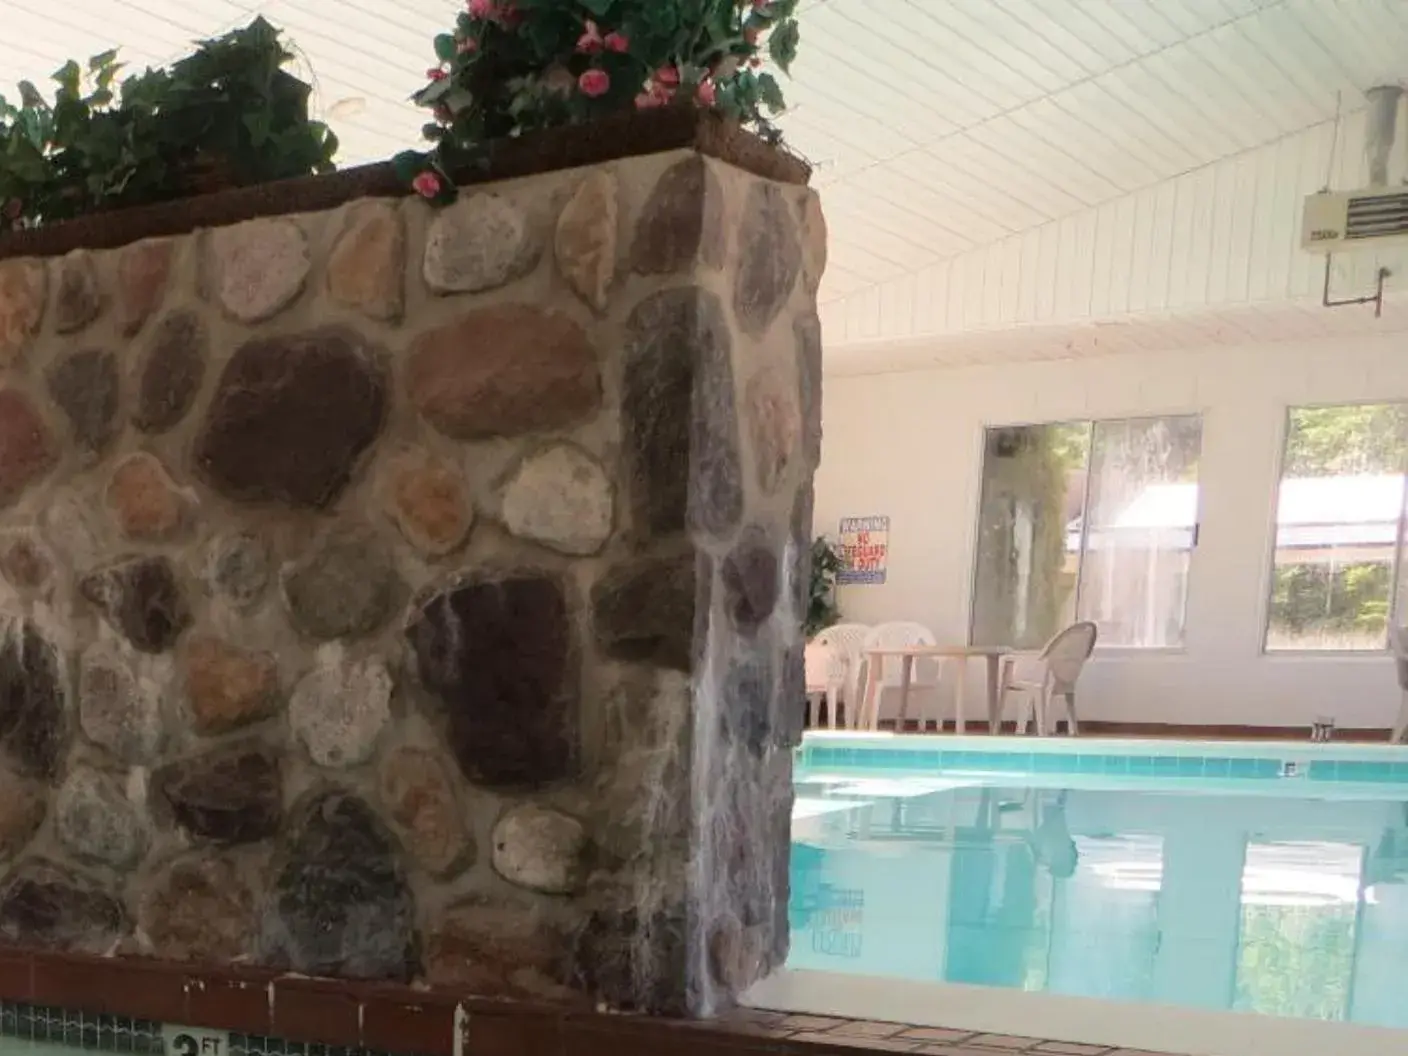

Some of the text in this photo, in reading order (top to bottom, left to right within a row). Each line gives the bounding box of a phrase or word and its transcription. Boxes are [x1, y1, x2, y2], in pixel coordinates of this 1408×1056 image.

[842, 518, 887, 531] WARNING
[857, 531, 870, 544] NO
[858, 557, 881, 571] DUTY
[202, 1036, 221, 1056] FT
